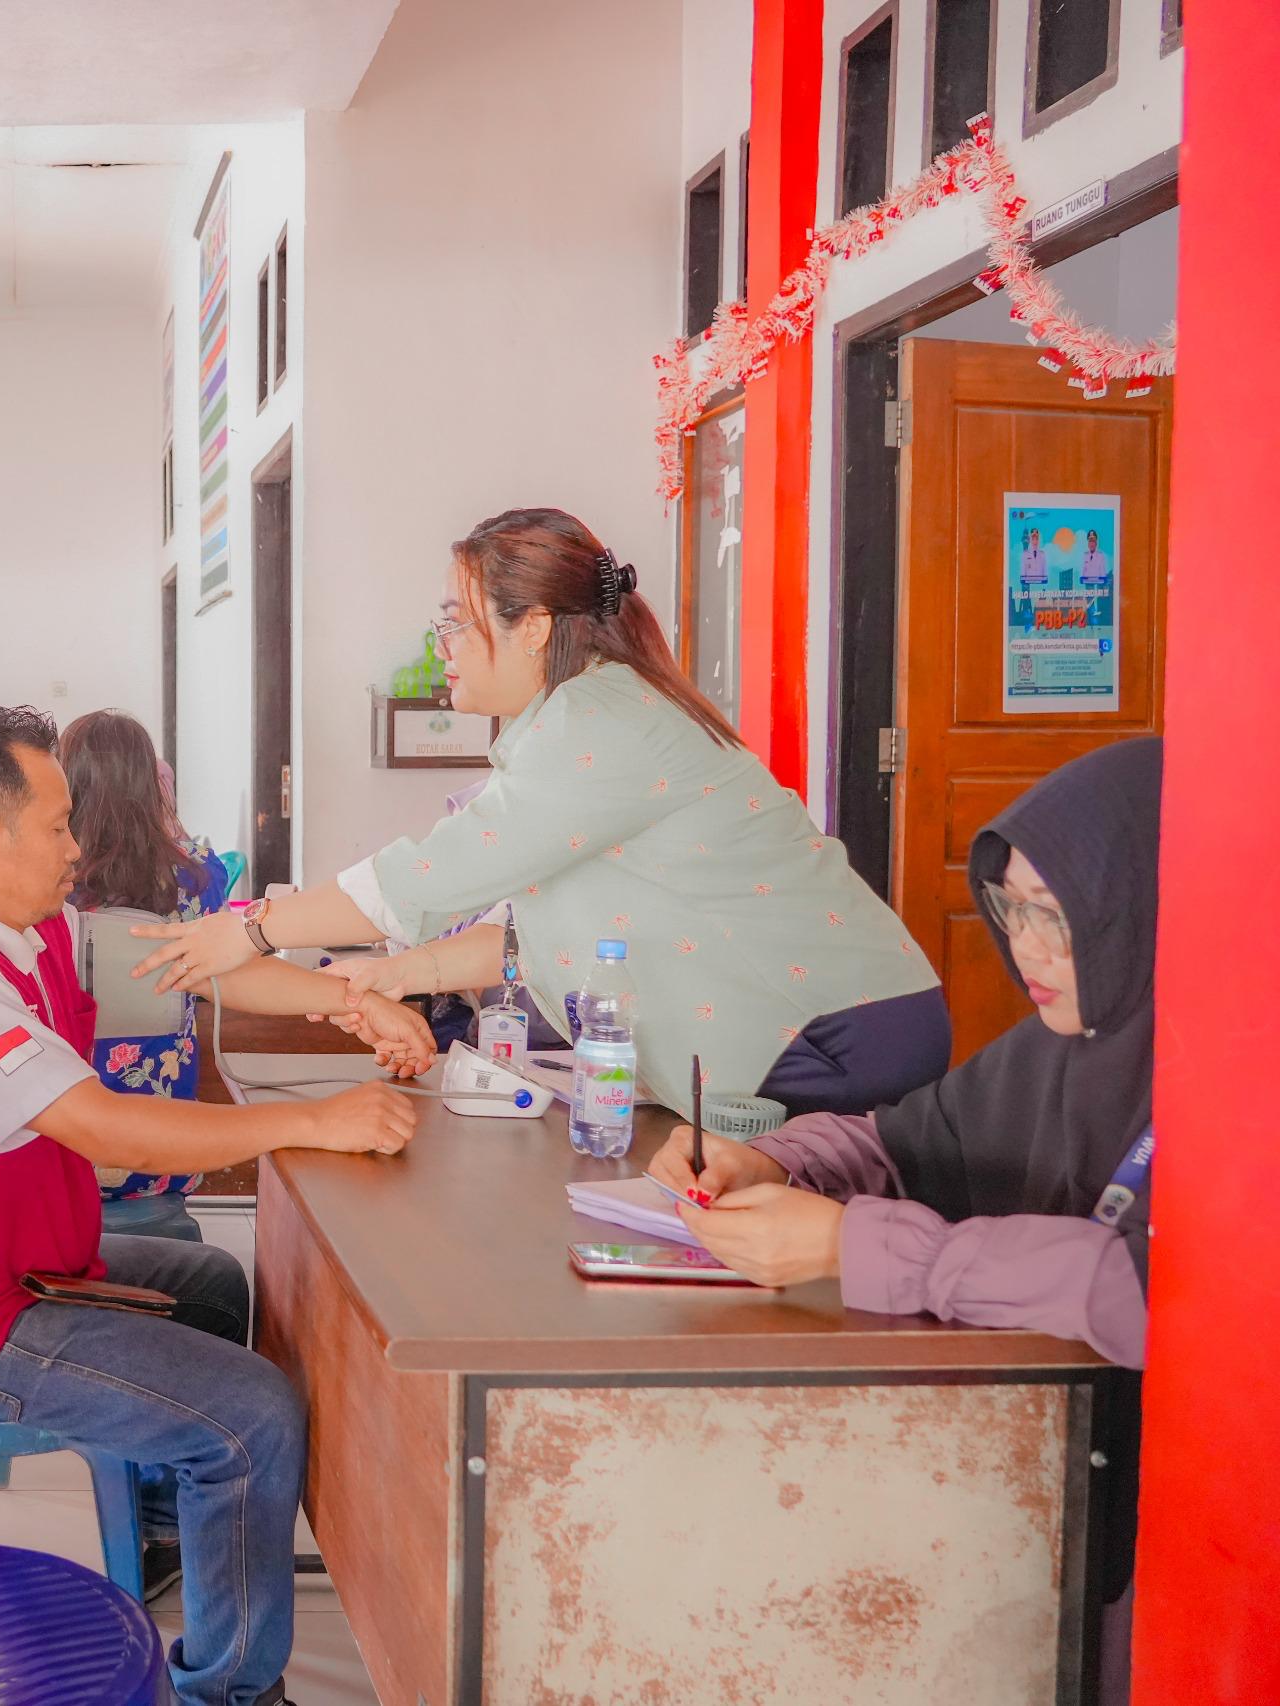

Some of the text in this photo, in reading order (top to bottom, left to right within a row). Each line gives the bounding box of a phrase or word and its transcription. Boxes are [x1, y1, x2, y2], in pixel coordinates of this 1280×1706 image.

[1035, 186, 1100, 232] RUANG TUNGGU
[1035, 608, 1087, 631] PBB-P2
[611, 1087, 625, 1098] Le
